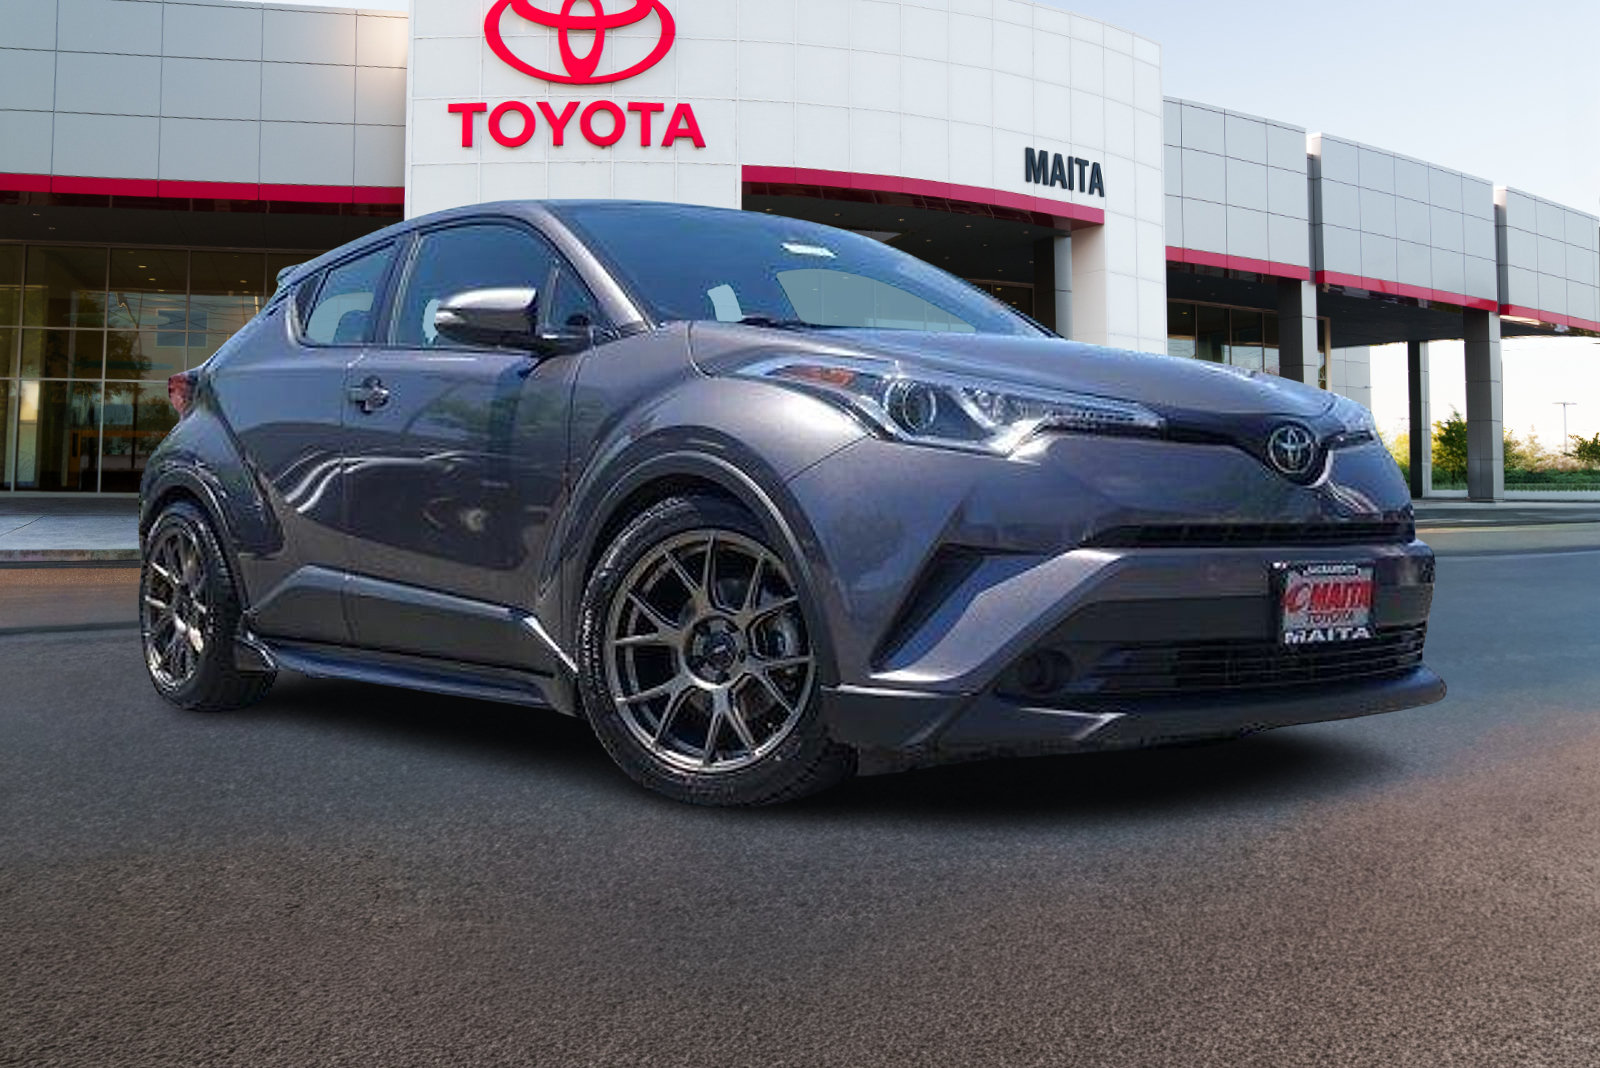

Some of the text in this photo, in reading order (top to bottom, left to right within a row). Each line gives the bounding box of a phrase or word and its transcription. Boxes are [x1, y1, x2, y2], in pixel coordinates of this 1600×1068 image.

[448, 100, 706, 148] TOYOTA
[1025, 147, 1104, 197] MAITA
[1284, 627, 1371, 644] MAITA
